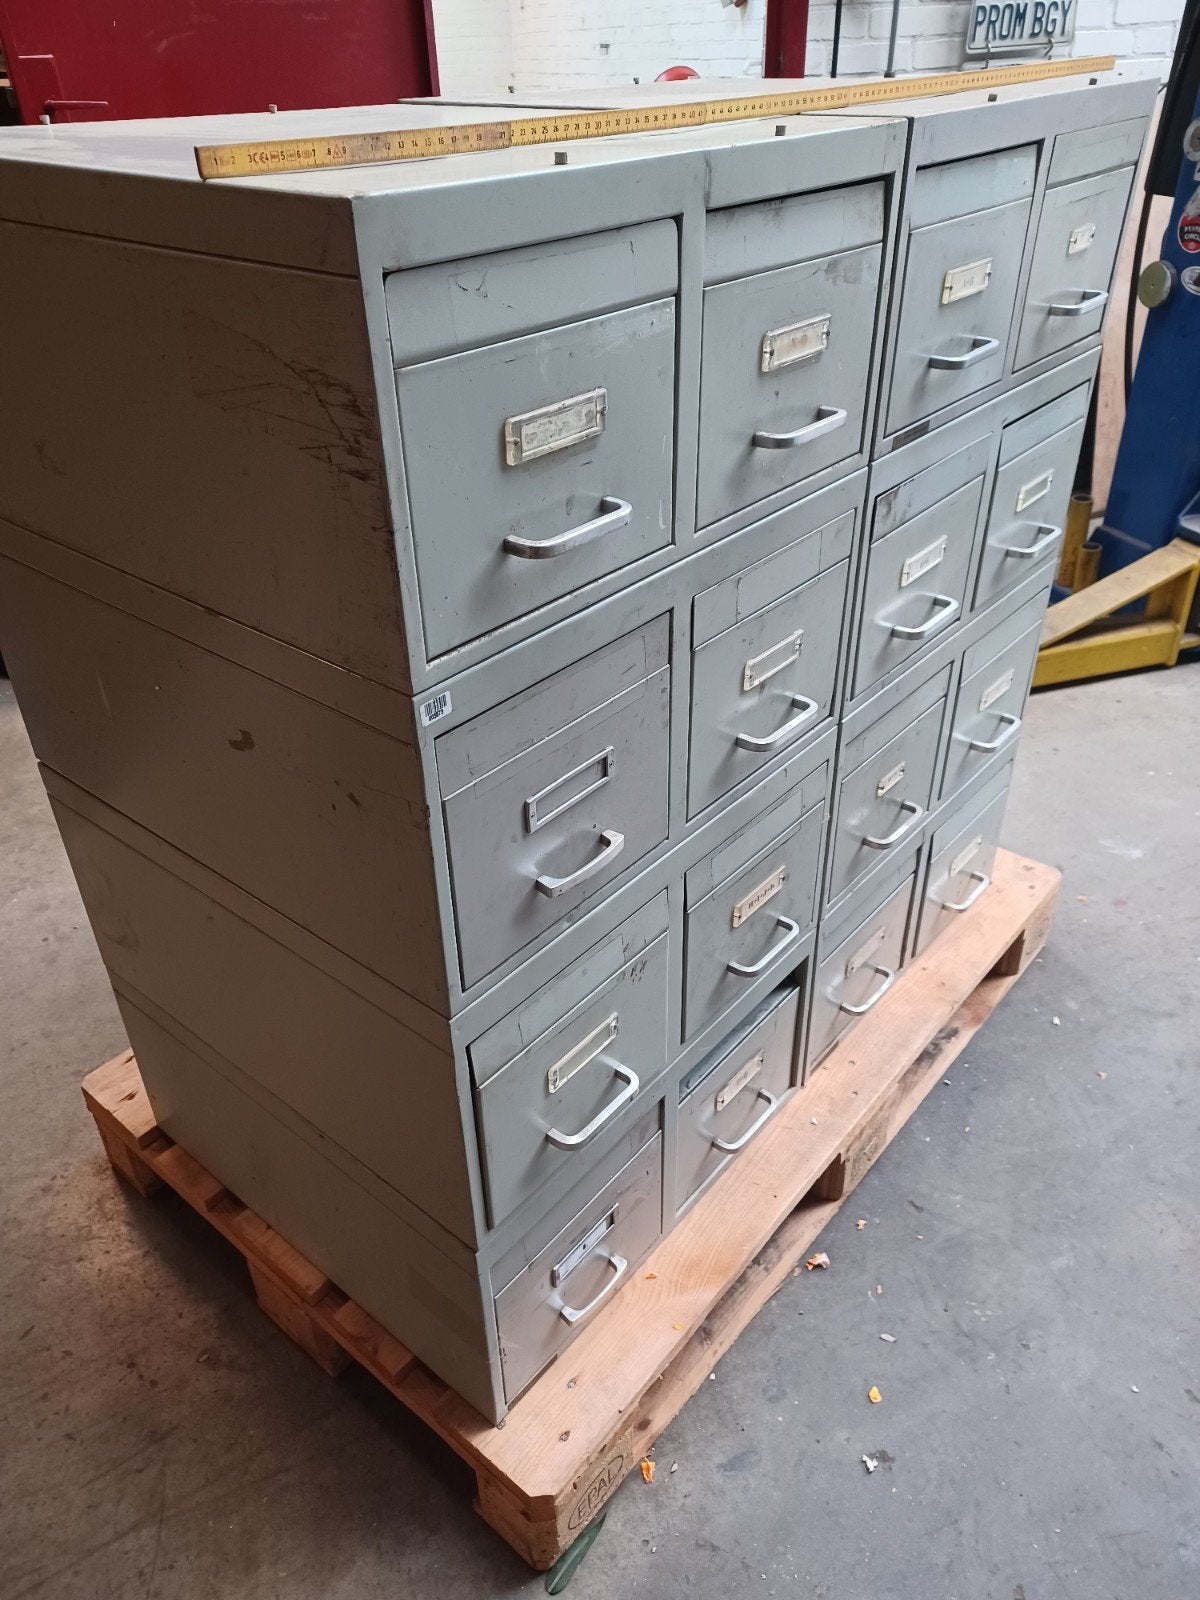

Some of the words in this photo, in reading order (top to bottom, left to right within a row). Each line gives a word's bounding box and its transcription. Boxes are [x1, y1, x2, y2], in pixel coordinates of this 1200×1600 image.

[971, 2, 1028, 42] PROM
[1030, 0, 1073, 37] BGY
[577, 1469, 615, 1519] EPAL
